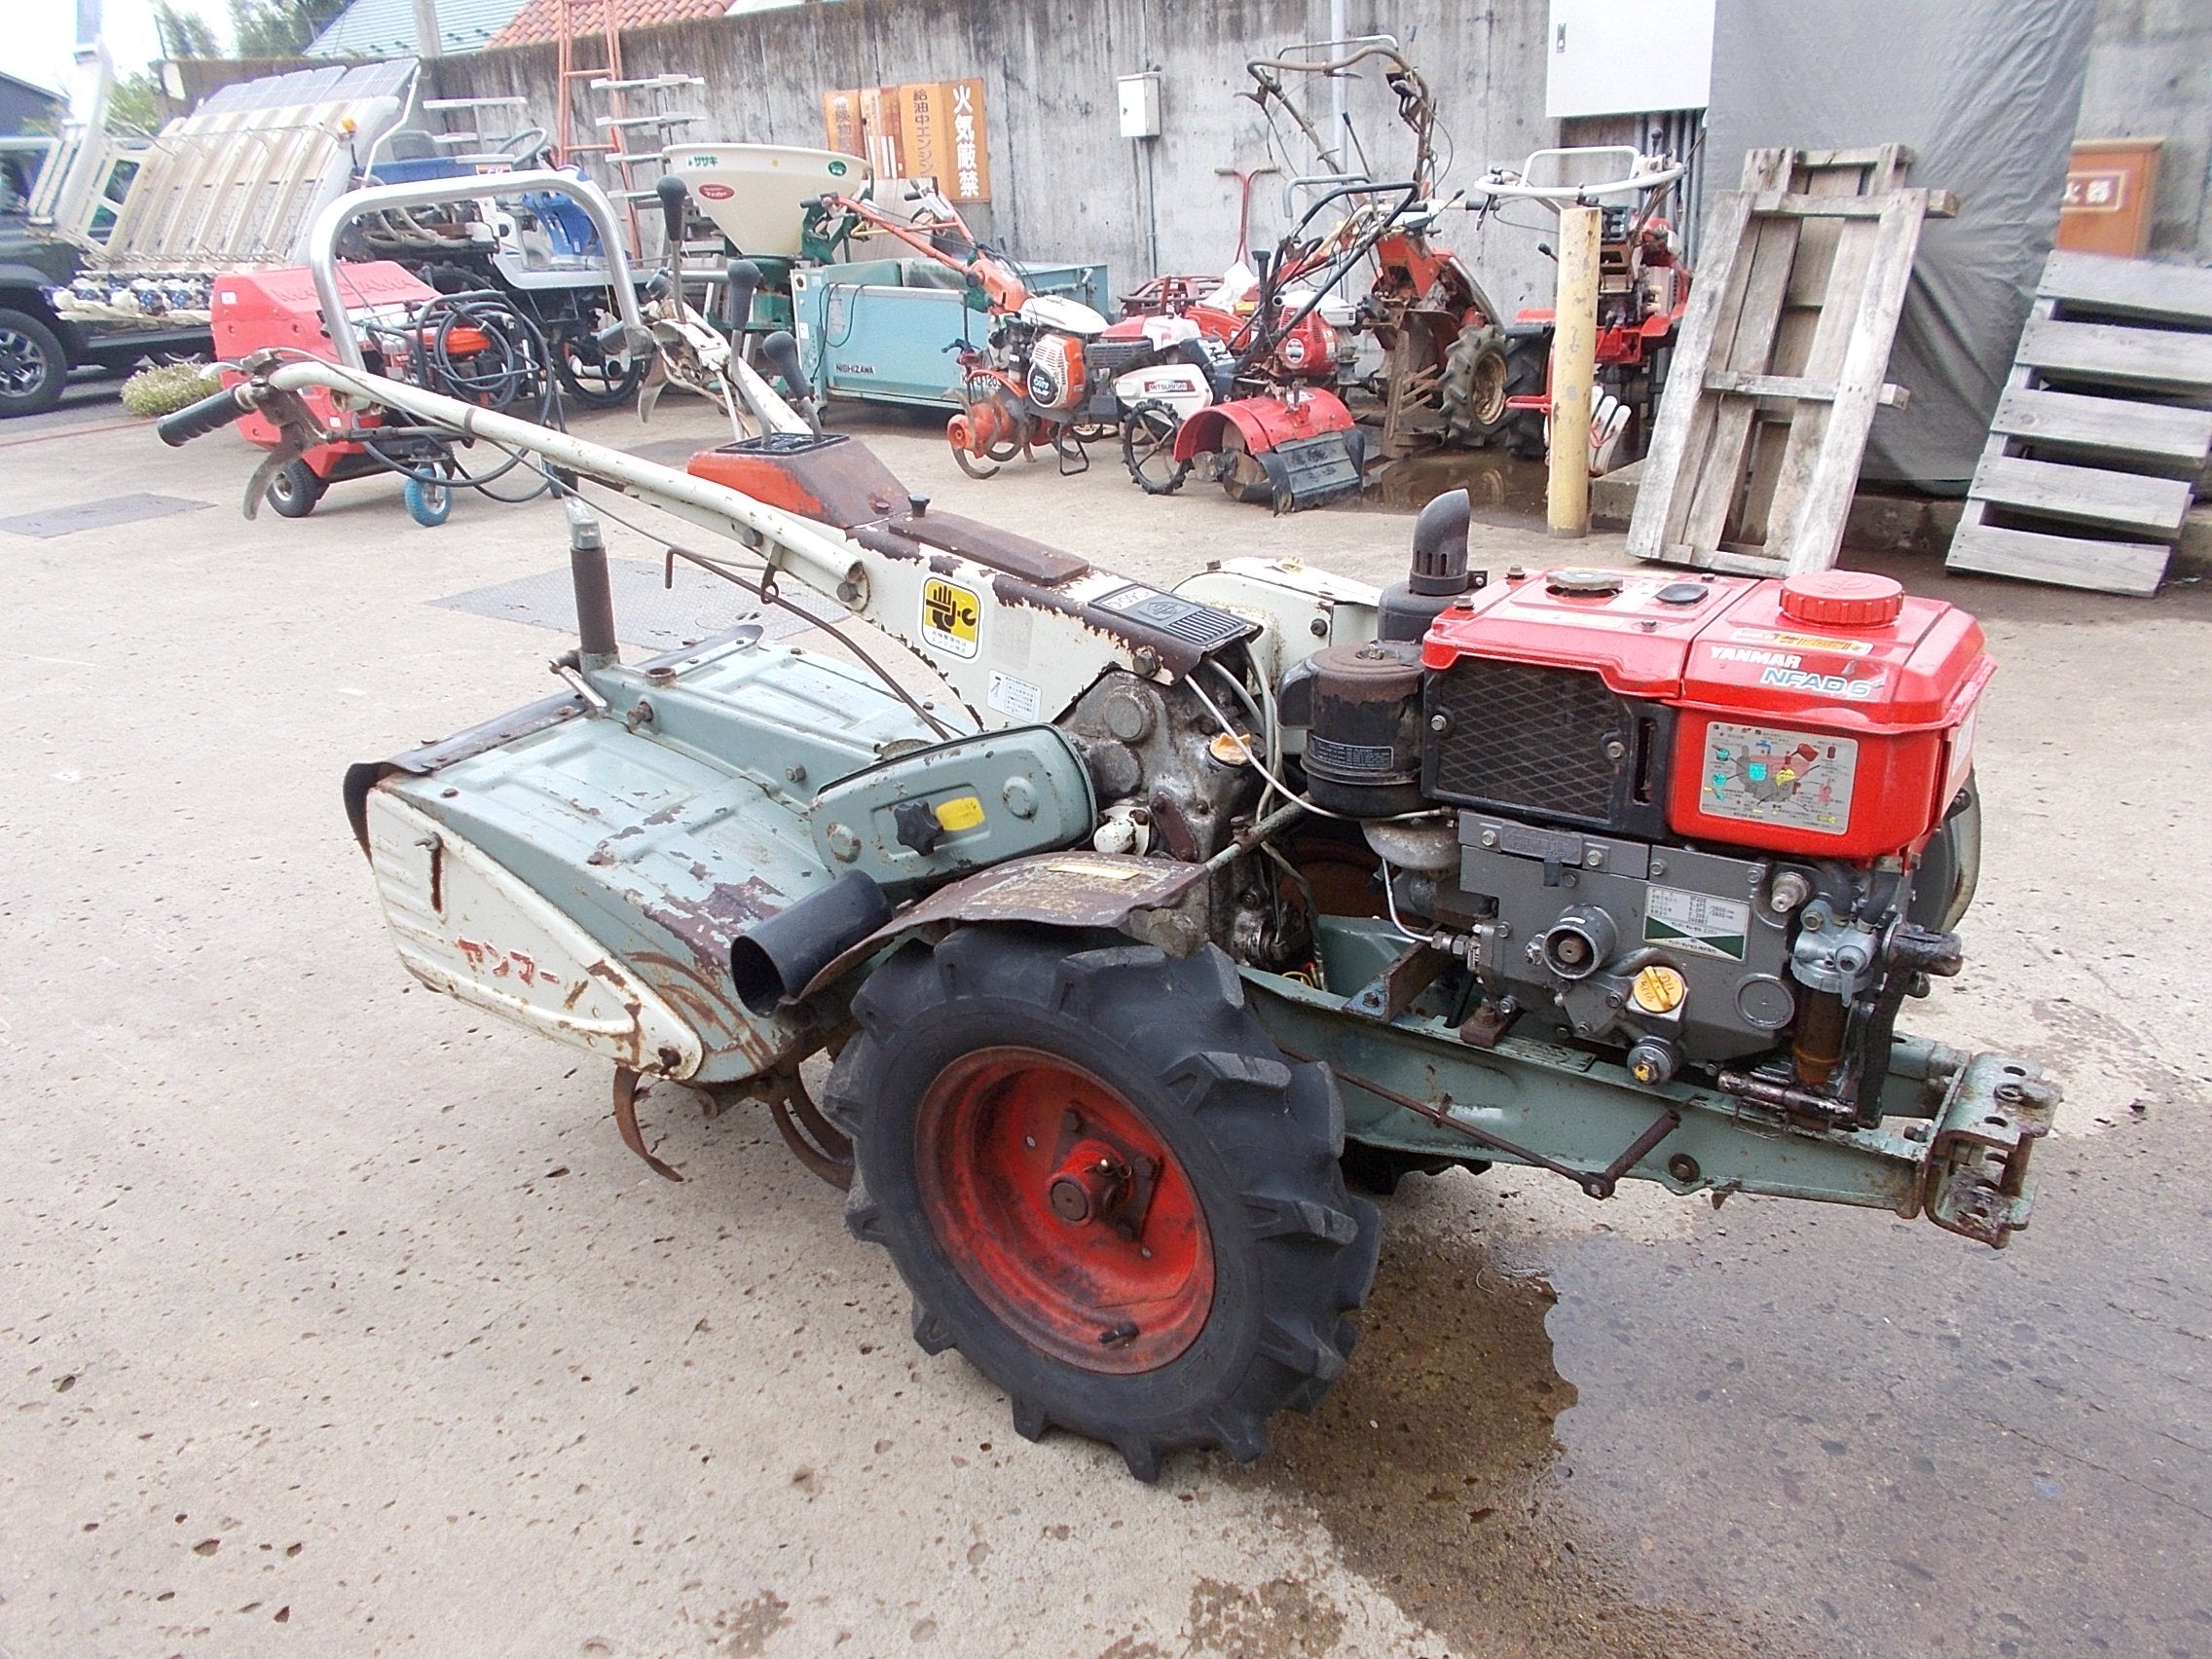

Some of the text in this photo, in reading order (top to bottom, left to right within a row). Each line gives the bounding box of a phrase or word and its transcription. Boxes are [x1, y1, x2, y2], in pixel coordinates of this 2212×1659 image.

[912, 88, 935, 178] 給油中エンジン
[953, 85, 979, 197] 火気厳禁
[835, 363, 874, 375] NISHIZAWA
[1711, 646, 1802, 669] YANMAR
